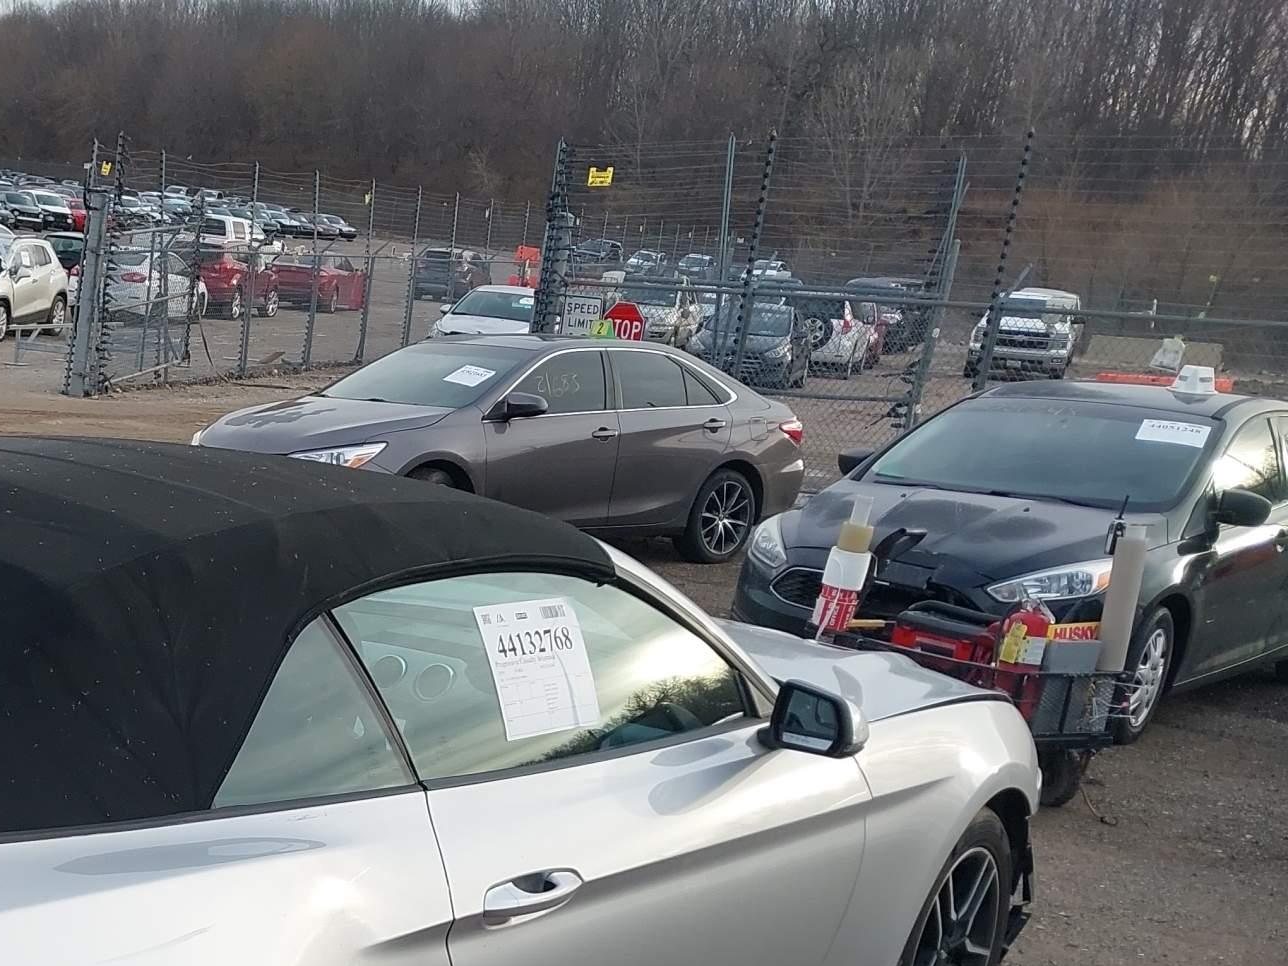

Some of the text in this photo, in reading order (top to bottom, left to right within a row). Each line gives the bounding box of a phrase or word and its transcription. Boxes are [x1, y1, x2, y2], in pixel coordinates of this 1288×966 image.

[567, 303, 599, 315] SPEED
[568, 317, 593, 329] LIMIT
[597, 322, 604, 335] 2
[606, 318, 641, 340] TOP
[498, 626, 573, 658] 44132768
